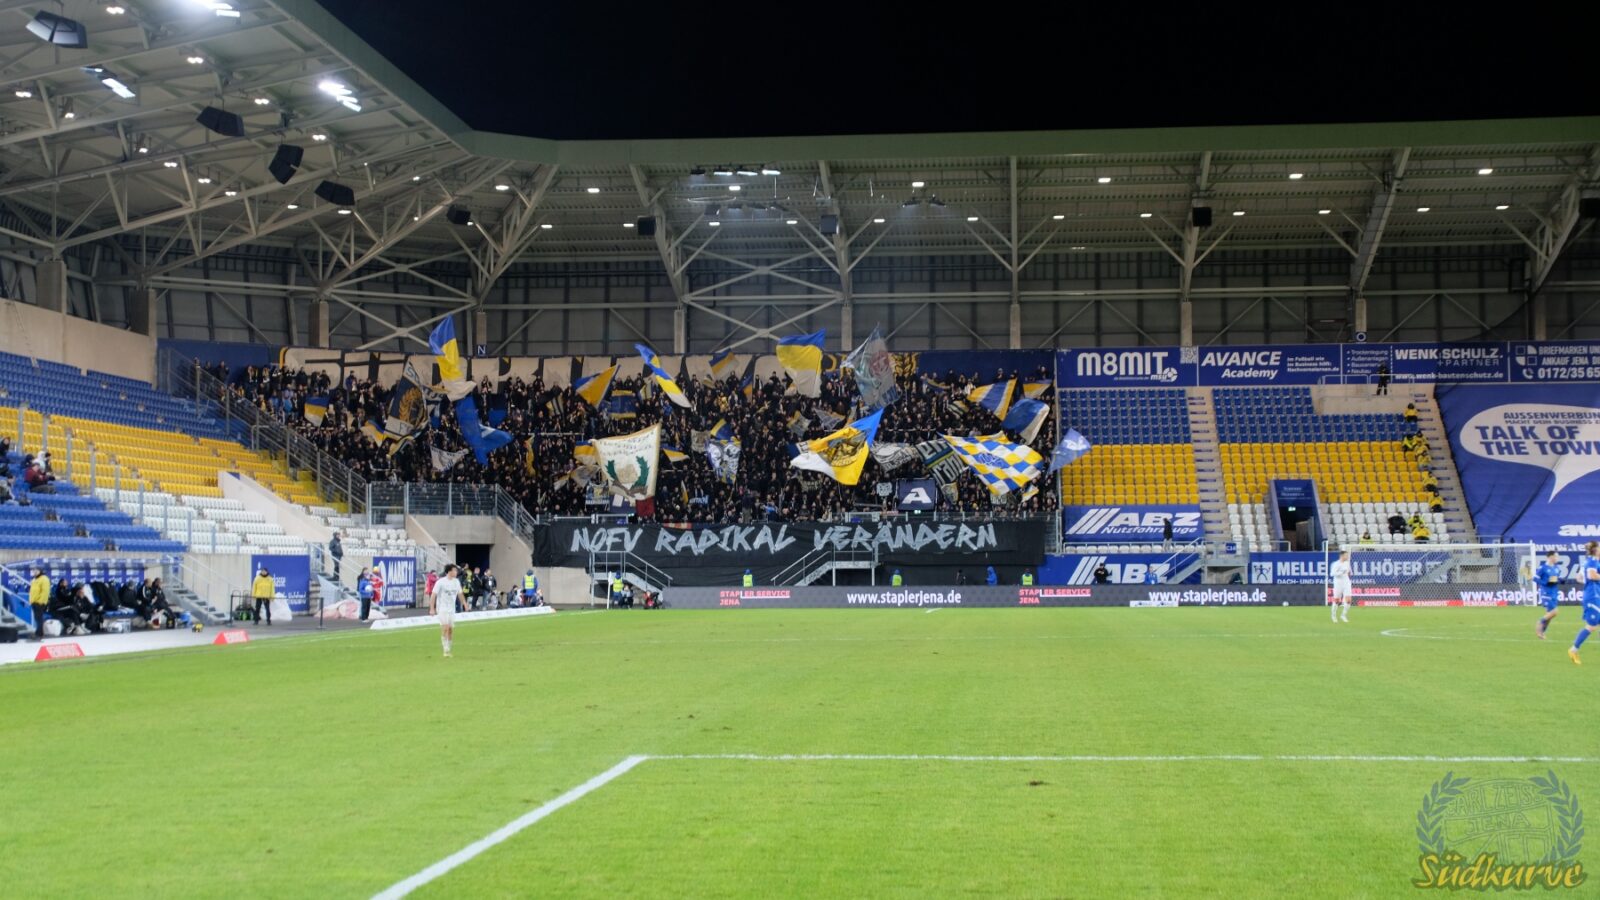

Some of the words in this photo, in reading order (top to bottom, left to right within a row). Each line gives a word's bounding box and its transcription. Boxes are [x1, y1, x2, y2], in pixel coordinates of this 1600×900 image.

[1394, 349, 1438, 360] WENK
[1538, 346, 1588, 355] BRIEFMARKEN
[1201, 351, 1282, 366] AVANCE
[1541, 356, 1570, 365] ANKAUF
[1571, 356, 1589, 365] JENA
[1221, 367, 1279, 380] Academy
[1475, 426, 1540, 440] TALK
[1547, 425, 1580, 440] OF
[1480, 441, 1530, 455] THE
[1108, 512, 1200, 526] ABZ
[1100, 526, 1198, 534] Nutzfahruge
[571, 527, 643, 552] NOFV
[655, 525, 796, 555] RADIKAL
[814, 521, 998, 552] VERÄNDERN
[1350, 559, 1422, 576] LLHÖFER
[720, 590, 754, 599] STAPLER
[847, 589, 961, 606] www.staplerjena.de
[1019, 588, 1054, 597] STAPLER
[1149, 588, 1266, 605] www.staplerjena.de
[1459, 587, 1583, 604] www.stapleja.de
